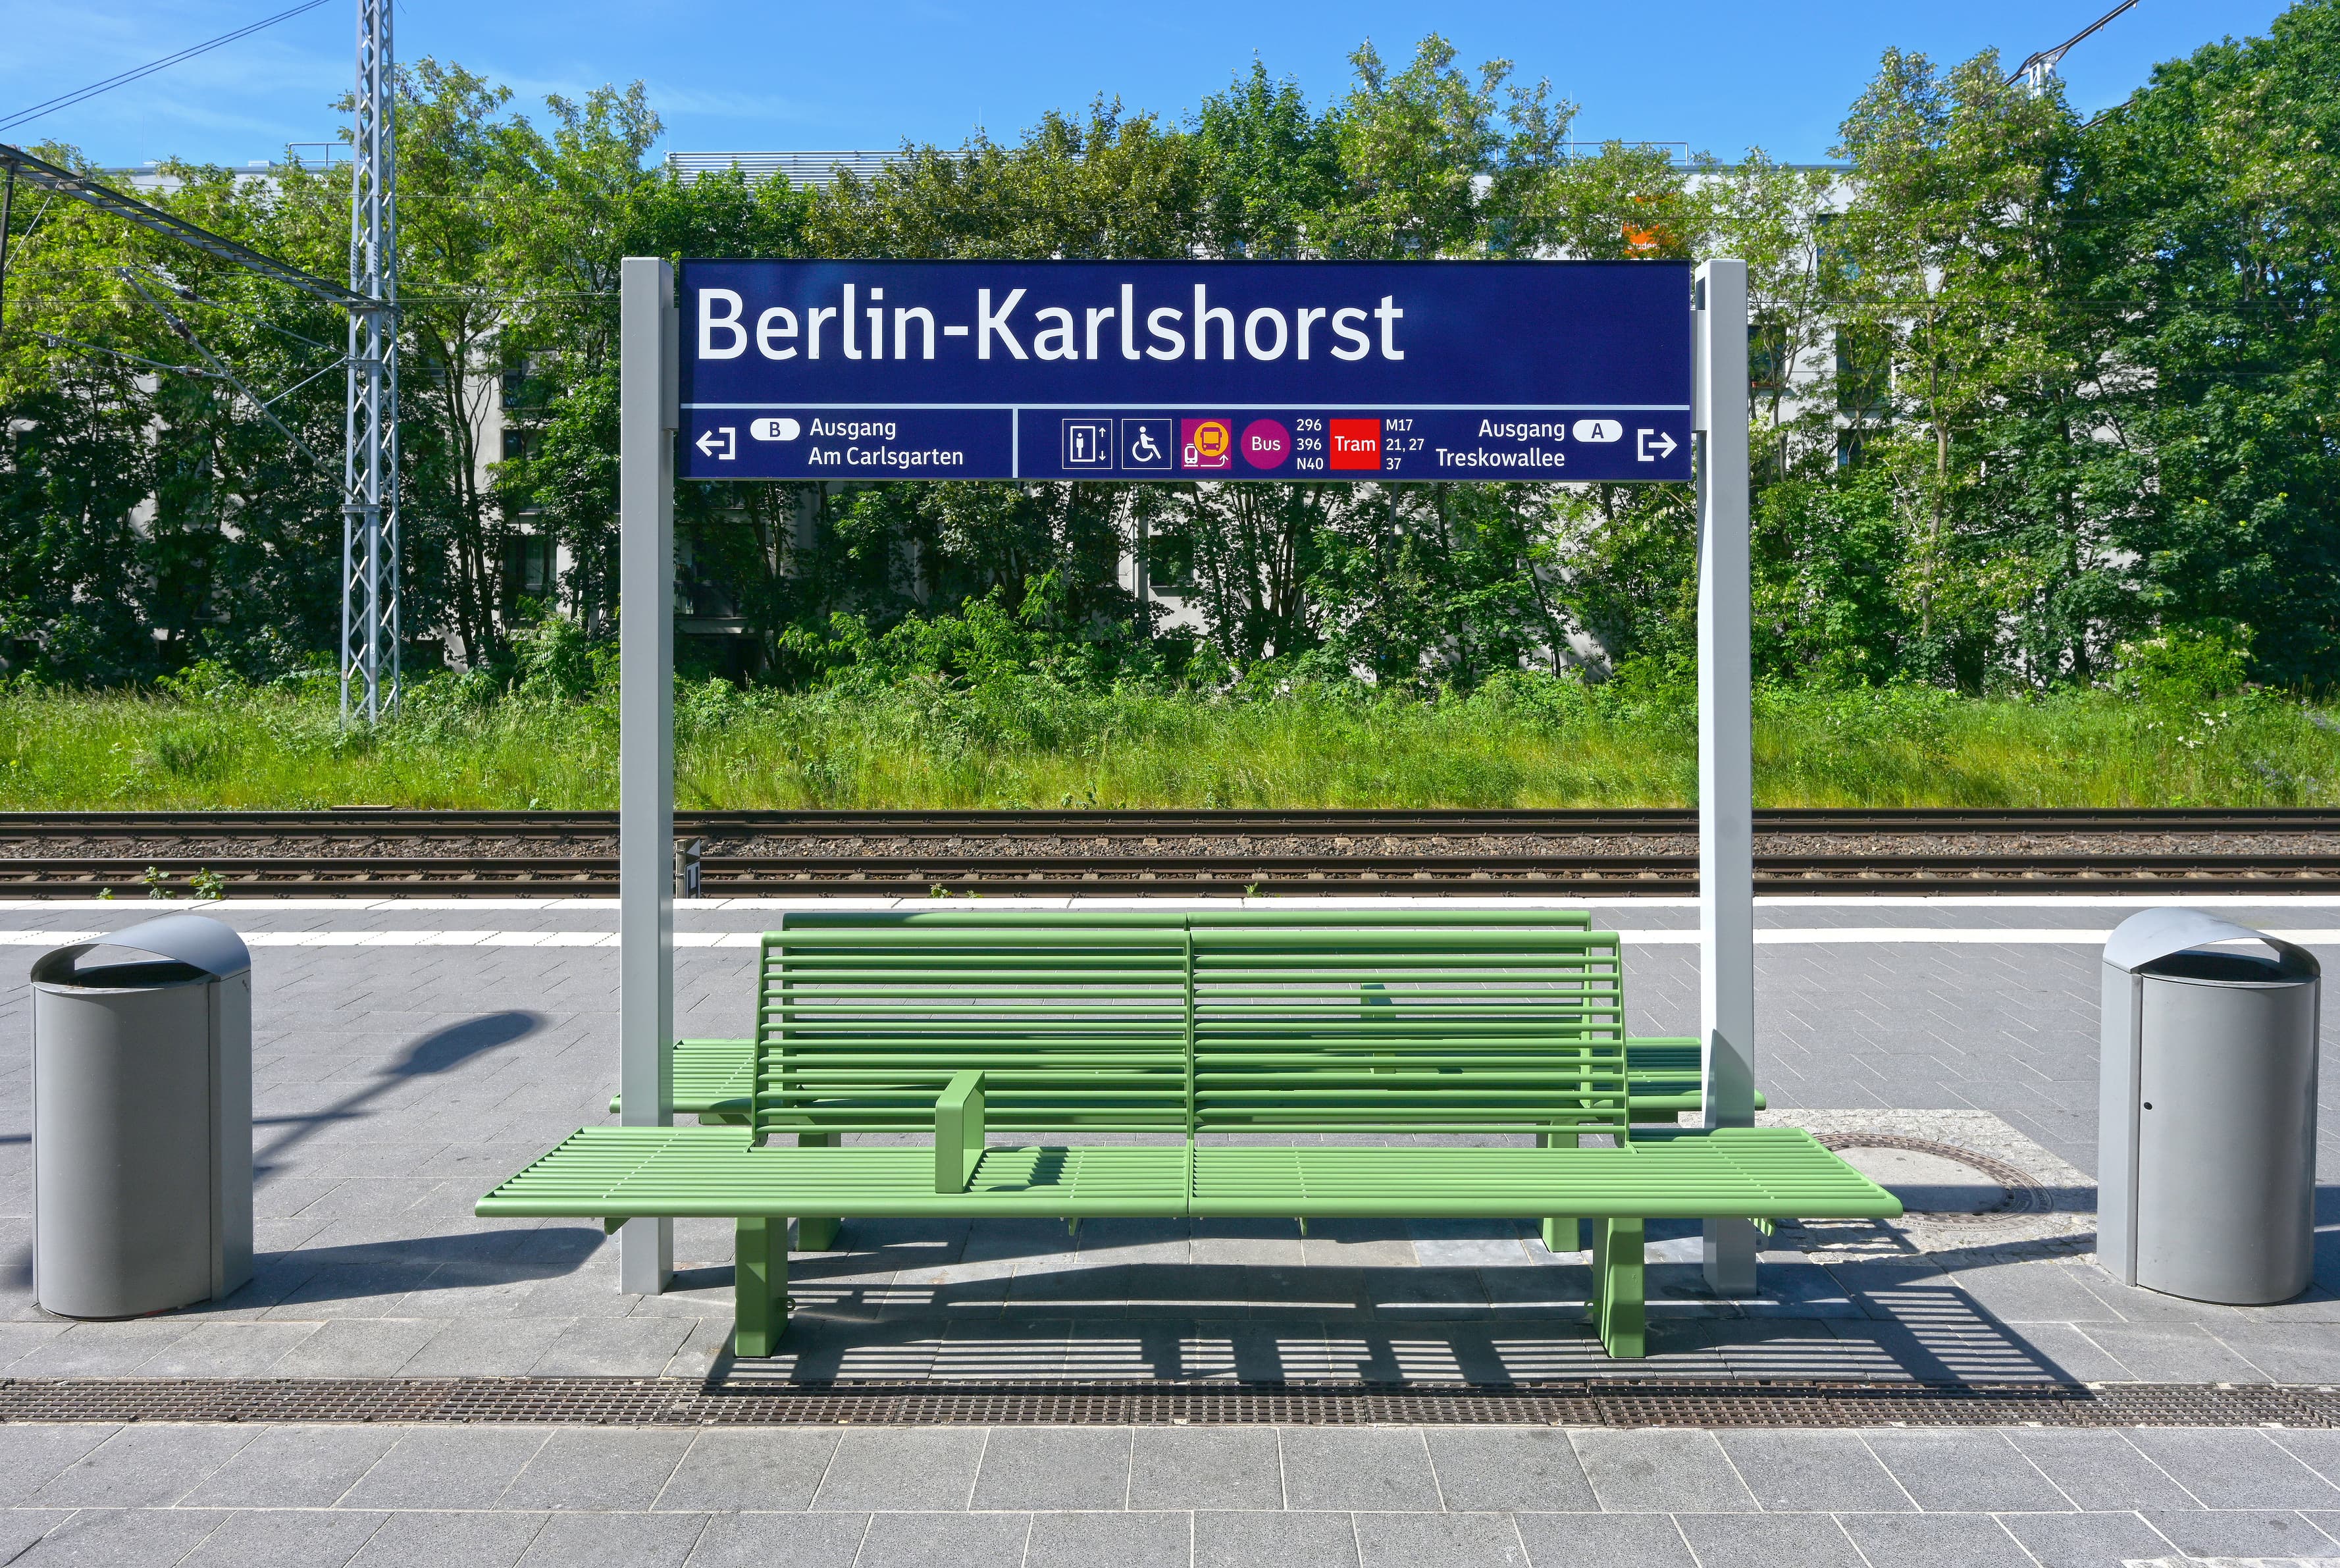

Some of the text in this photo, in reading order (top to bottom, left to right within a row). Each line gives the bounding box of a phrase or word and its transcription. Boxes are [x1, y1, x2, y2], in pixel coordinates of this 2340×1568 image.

[698, 283, 1405, 361] Berlin-Karlshorst
[769, 421, 781, 438] B
[810, 418, 896, 440] Ausgang
[1297, 419, 1322, 431] 296
[1386, 419, 1413, 431] M17
[1478, 419, 1565, 442] Ausgang
[1591, 423, 1604, 439] A
[1252, 436, 1281, 451] Bus
[1297, 438, 1322, 450] 396
[1334, 436, 1376, 452] Tram
[1386, 438, 1424, 453] 21, 27
[808, 446, 963, 469] Am Carlsgarten
[1297, 457, 1324, 470] N40
[1386, 457, 1401, 470] 37
[1436, 447, 1565, 467] Treskowallee
